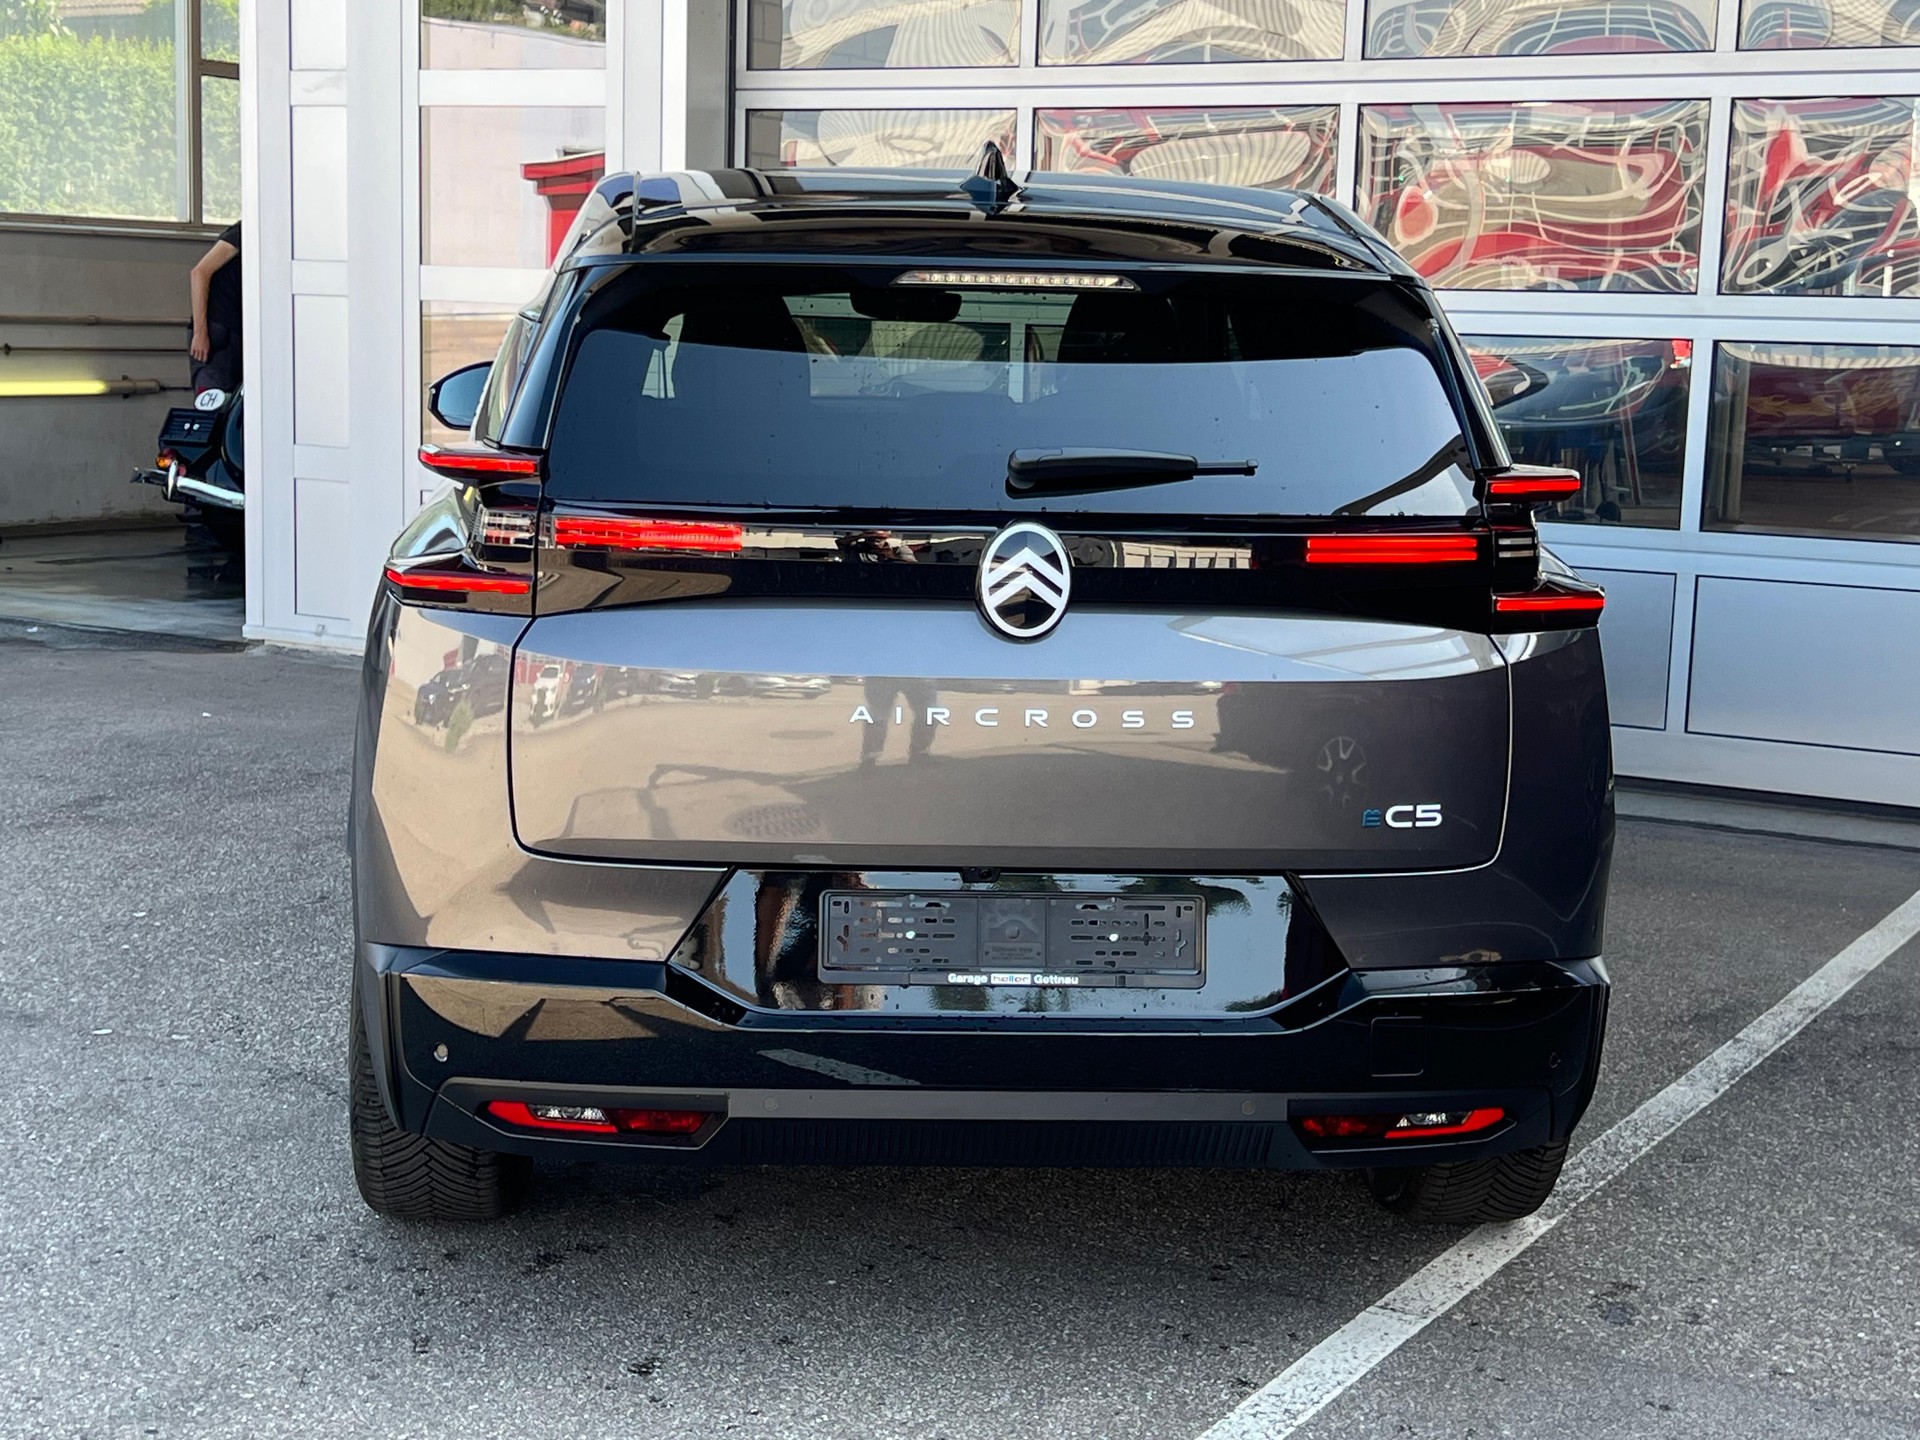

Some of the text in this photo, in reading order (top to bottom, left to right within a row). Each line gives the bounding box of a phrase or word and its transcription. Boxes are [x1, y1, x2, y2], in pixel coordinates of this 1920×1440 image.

[200, 391, 218, 407] CH
[849, 705, 1195, 728] AIRCROSS
[948, 973, 988, 985] Garage
